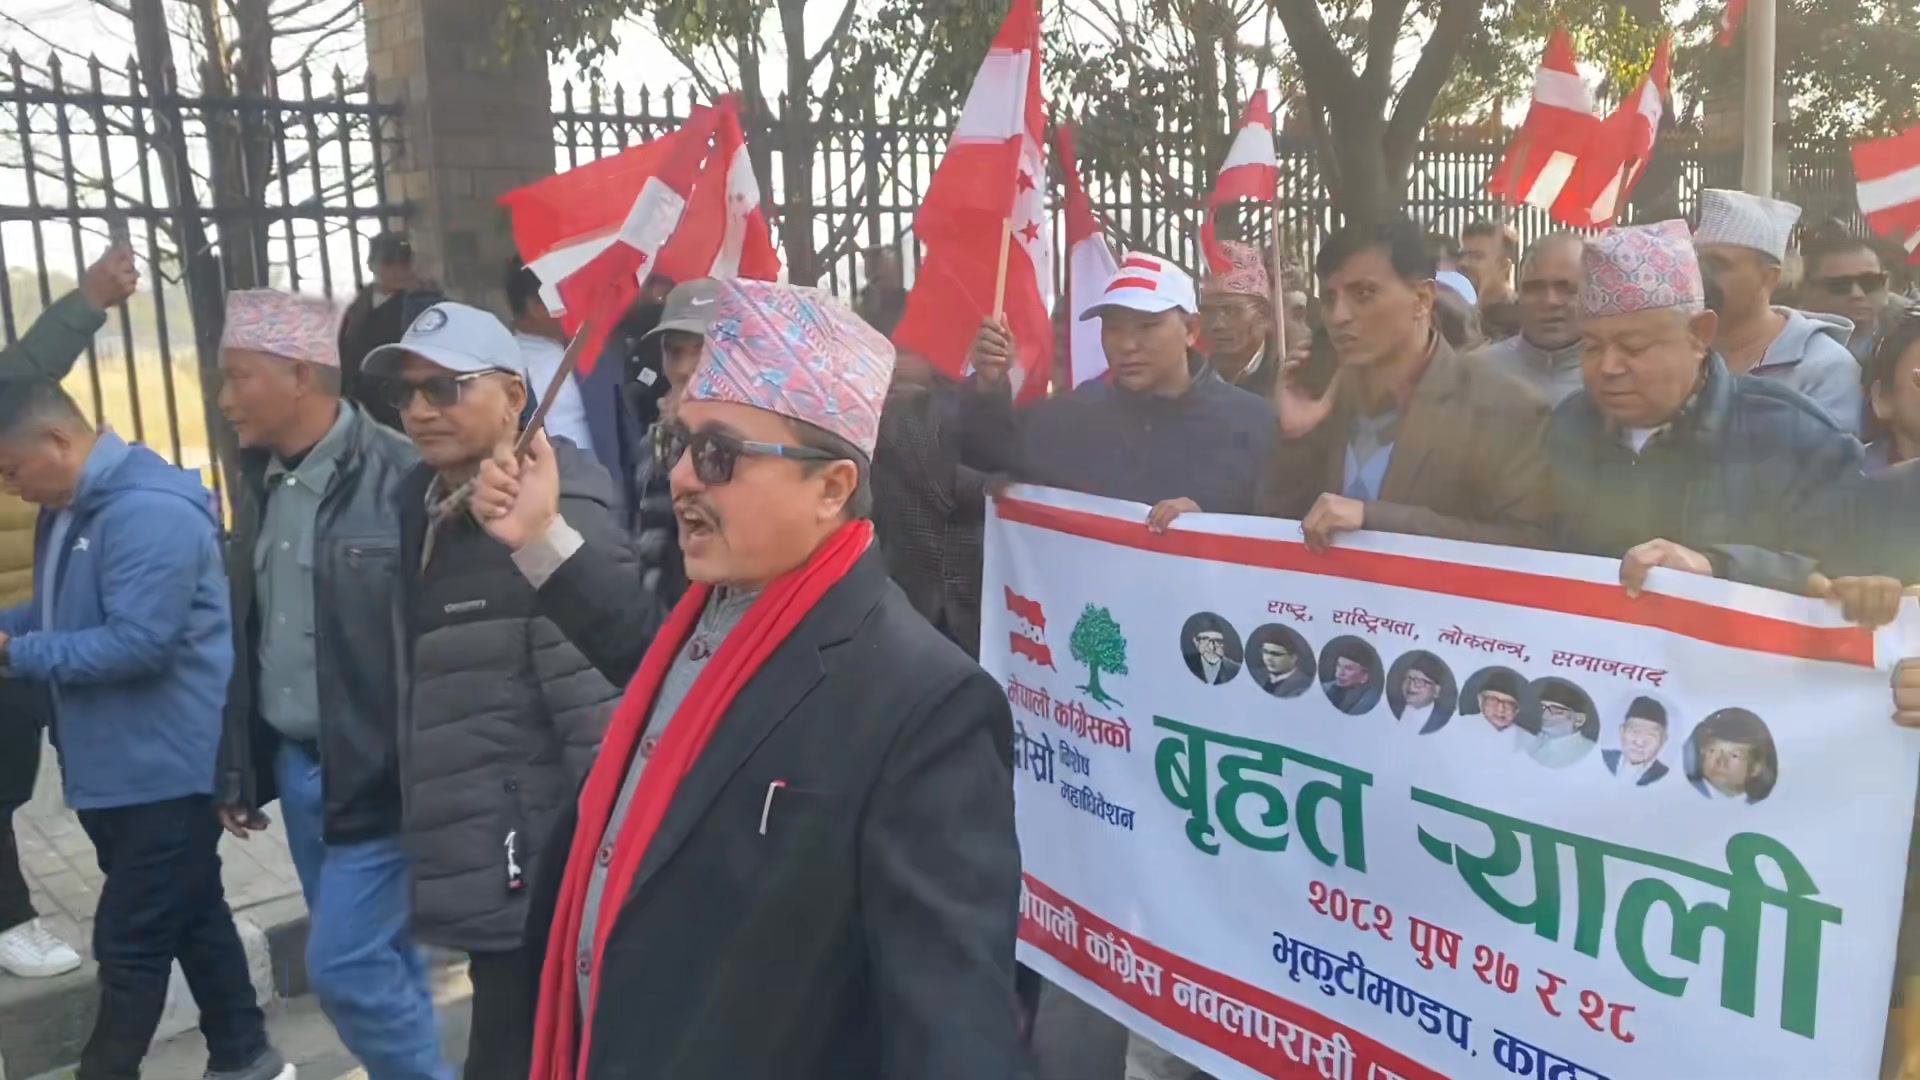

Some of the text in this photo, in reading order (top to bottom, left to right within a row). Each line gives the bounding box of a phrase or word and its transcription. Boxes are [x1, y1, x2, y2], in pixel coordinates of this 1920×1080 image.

[1551, 650, 1668, 686] समाजवाद
[1153, 714, 1374, 875] बृहत
[1308, 880, 1636, 1043] २०८२ पुष २७ र २८
